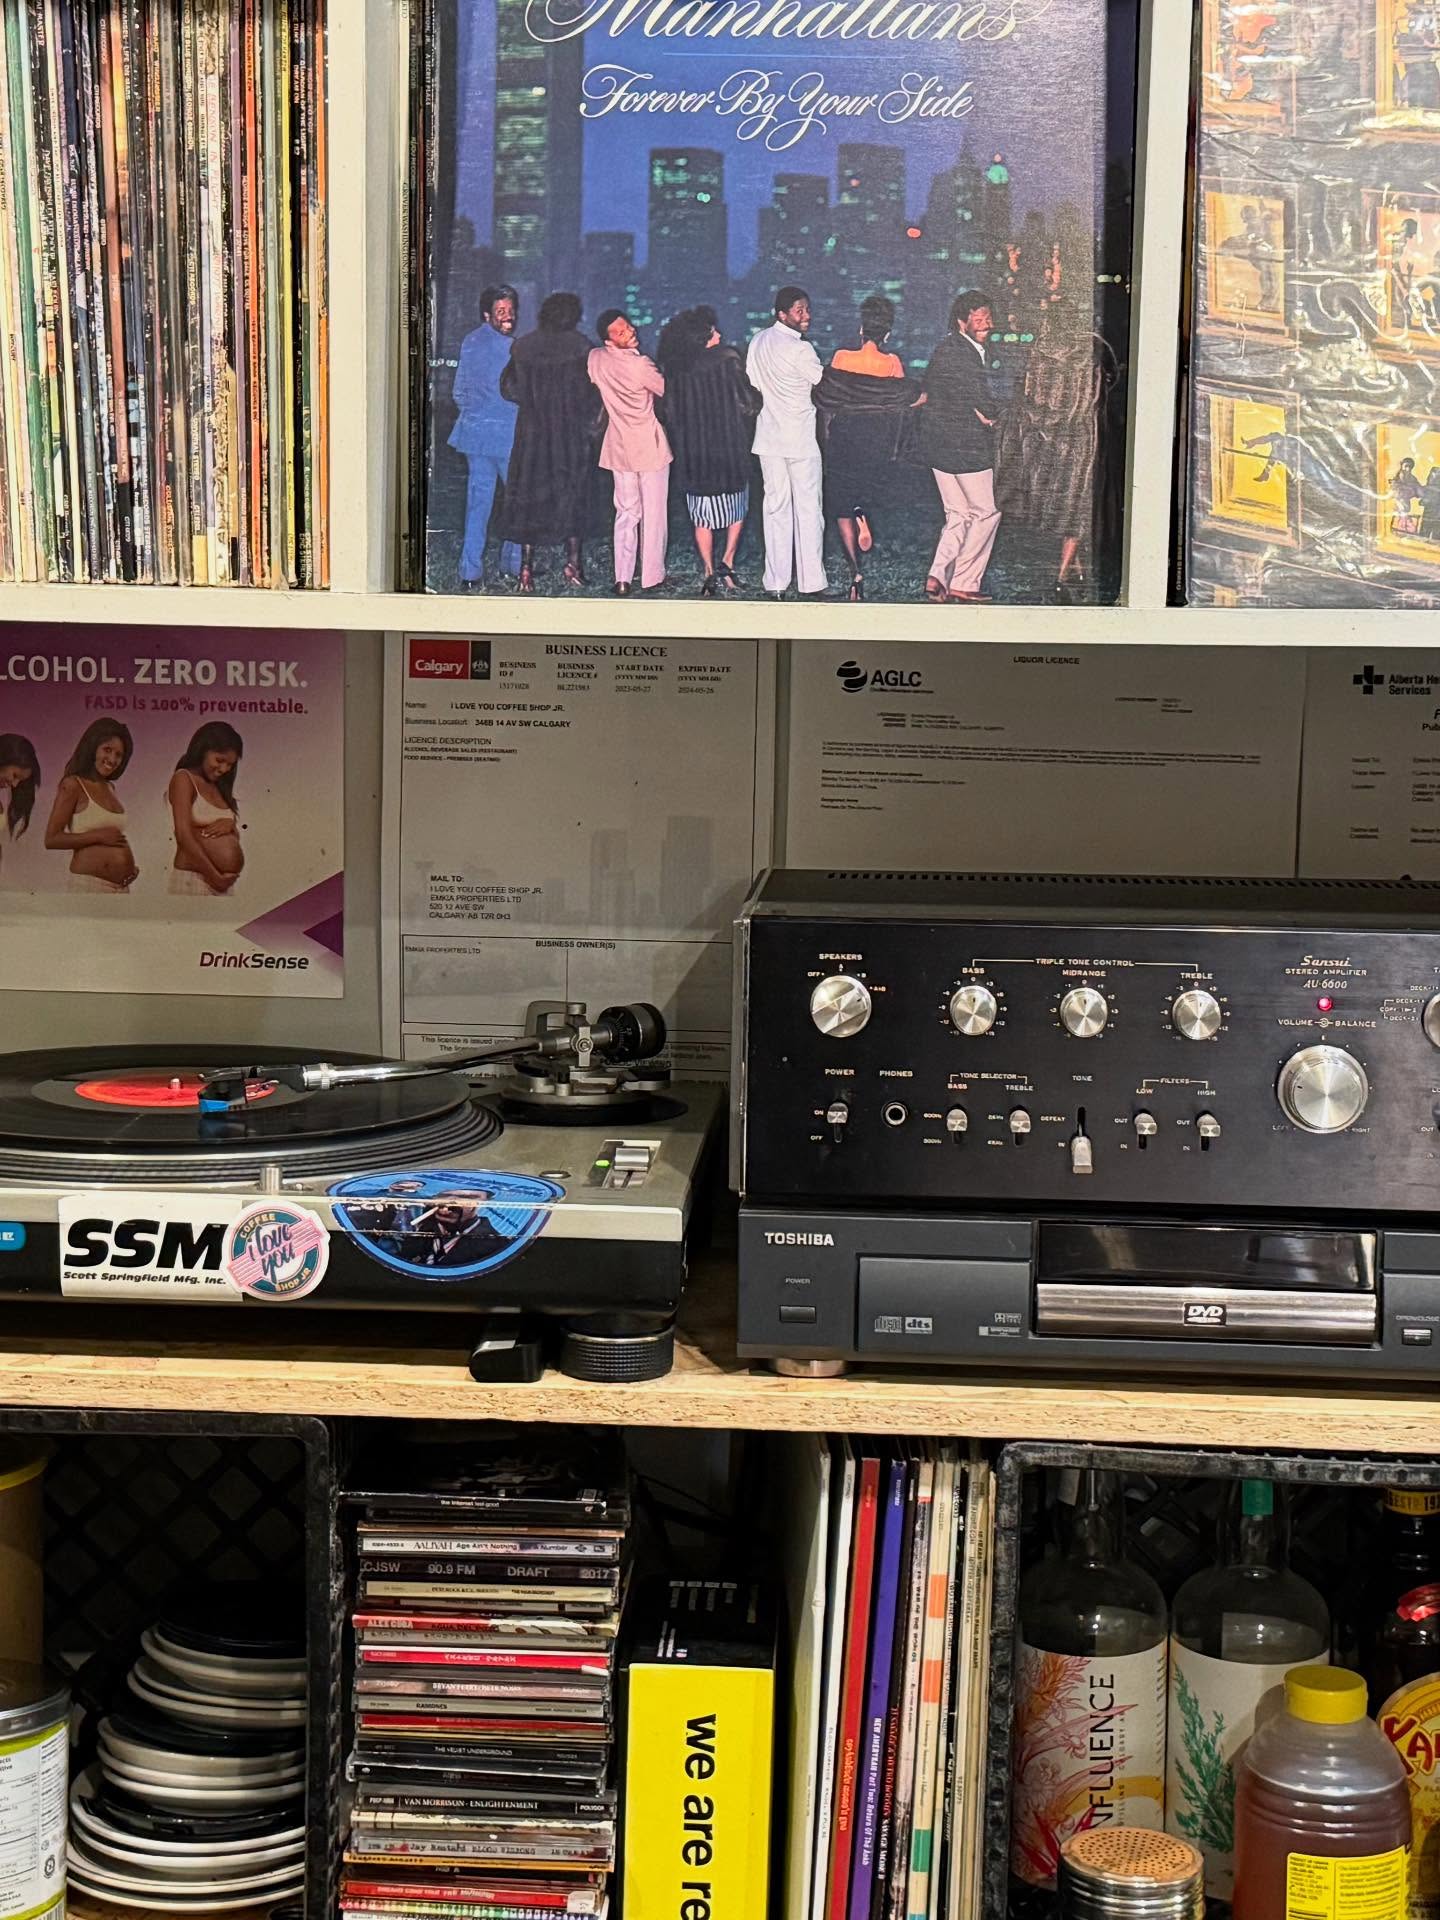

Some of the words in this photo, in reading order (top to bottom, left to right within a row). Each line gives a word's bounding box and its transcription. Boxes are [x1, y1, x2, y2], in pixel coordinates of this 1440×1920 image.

[579, 63, 716, 118] Forever
[717, 69, 780, 142] By
[767, 71, 879, 152] Your
[878, 72, 975, 125] Side
[545, 644, 607, 656] BUSINESS
[609, 645, 668, 657] LICENCE
[0, 655, 125, 684] COHOL.
[134, 658, 217, 687] ZERO
[226, 660, 309, 688] RISK.
[414, 658, 464, 675] Calgary
[557, 662, 595, 670] BUSINESS
[871, 669, 923, 687] AGLC
[1388, 674, 1424, 685] Alberta
[1388, 684, 1432, 696] Services
[84, 695, 128, 711] FASD
[150, 699, 195, 713] 100%
[199, 699, 309, 716] preventable.
[475, 886, 507, 894] COFFEE
[535, 940, 575, 948] BUSINESS
[199, 951, 310, 970] DrinkSense
[818, 953, 863, 961] SPEAKERS
[1092, 959, 1135, 967] CONTROL
[1300, 954, 1351, 968] Sansui
[1062, 969, 1107, 977] MIDRANGE
[1180, 972, 1214, 980] TREBLE
[1322, 968, 1368, 976] AMPLIFIER
[1277, 1019, 1314, 1027] VOLUME
[1335, 1020, 1377, 1028] BALANCE
[824, 1068, 855, 1076] POWER
[879, 1070, 913, 1078] PHONES
[1005, 1084, 1034, 1092] TREBLE
[240, 1213, 276, 1239] COFFEE
[63, 1217, 230, 1271] SSM
[764, 1231, 834, 1247] TOSHIBA
[63, 1270, 98, 1281] Scott
[100, 1272, 170, 1284] Springfield
[173, 1274, 201, 1285] Mfg.
[204, 1276, 228, 1286] Inc.
[275, 1277, 300, 1292] SHOP
[1187, 1304, 1224, 1318] DVD
[906, 1318, 931, 1329] dts
[455, 1542, 472, 1551] Age
[362, 1561, 401, 1573] CJSW
[427, 1563, 454, 1575] 90.9
[457, 1564, 476, 1576] FM
[506, 1565, 551, 1579] DRAFT
[684, 1712, 717, 1780] we
[1089, 1674, 1115, 1828] NFLUENCE
[681, 1793, 714, 1867] are
